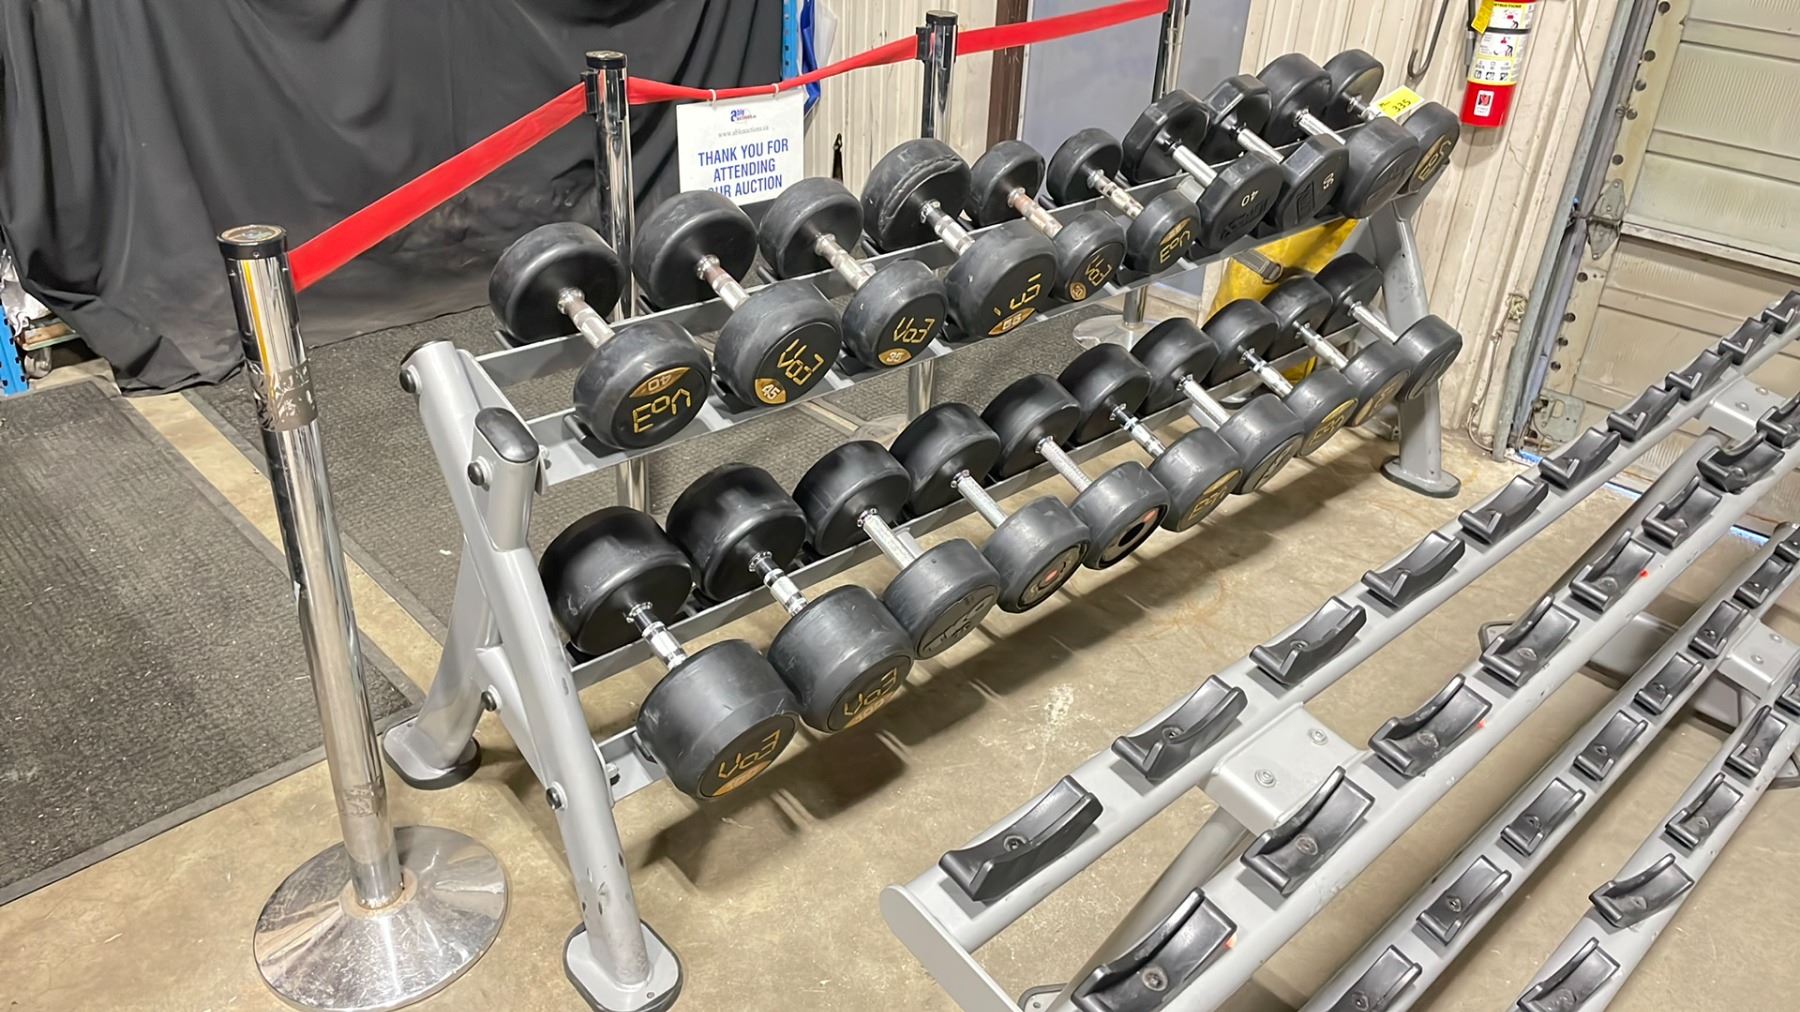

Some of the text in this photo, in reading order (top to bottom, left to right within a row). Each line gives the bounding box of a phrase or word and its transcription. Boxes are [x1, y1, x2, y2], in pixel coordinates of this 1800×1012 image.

[1392, 99, 1411, 111] 335
[698, 138, 789, 167] THANK YOU FOR
[713, 158, 776, 183] ATTENDING
[735, 174, 782, 197] AUCTION
[647, 373, 672, 392] 40
[761, 382, 781, 400] 45
